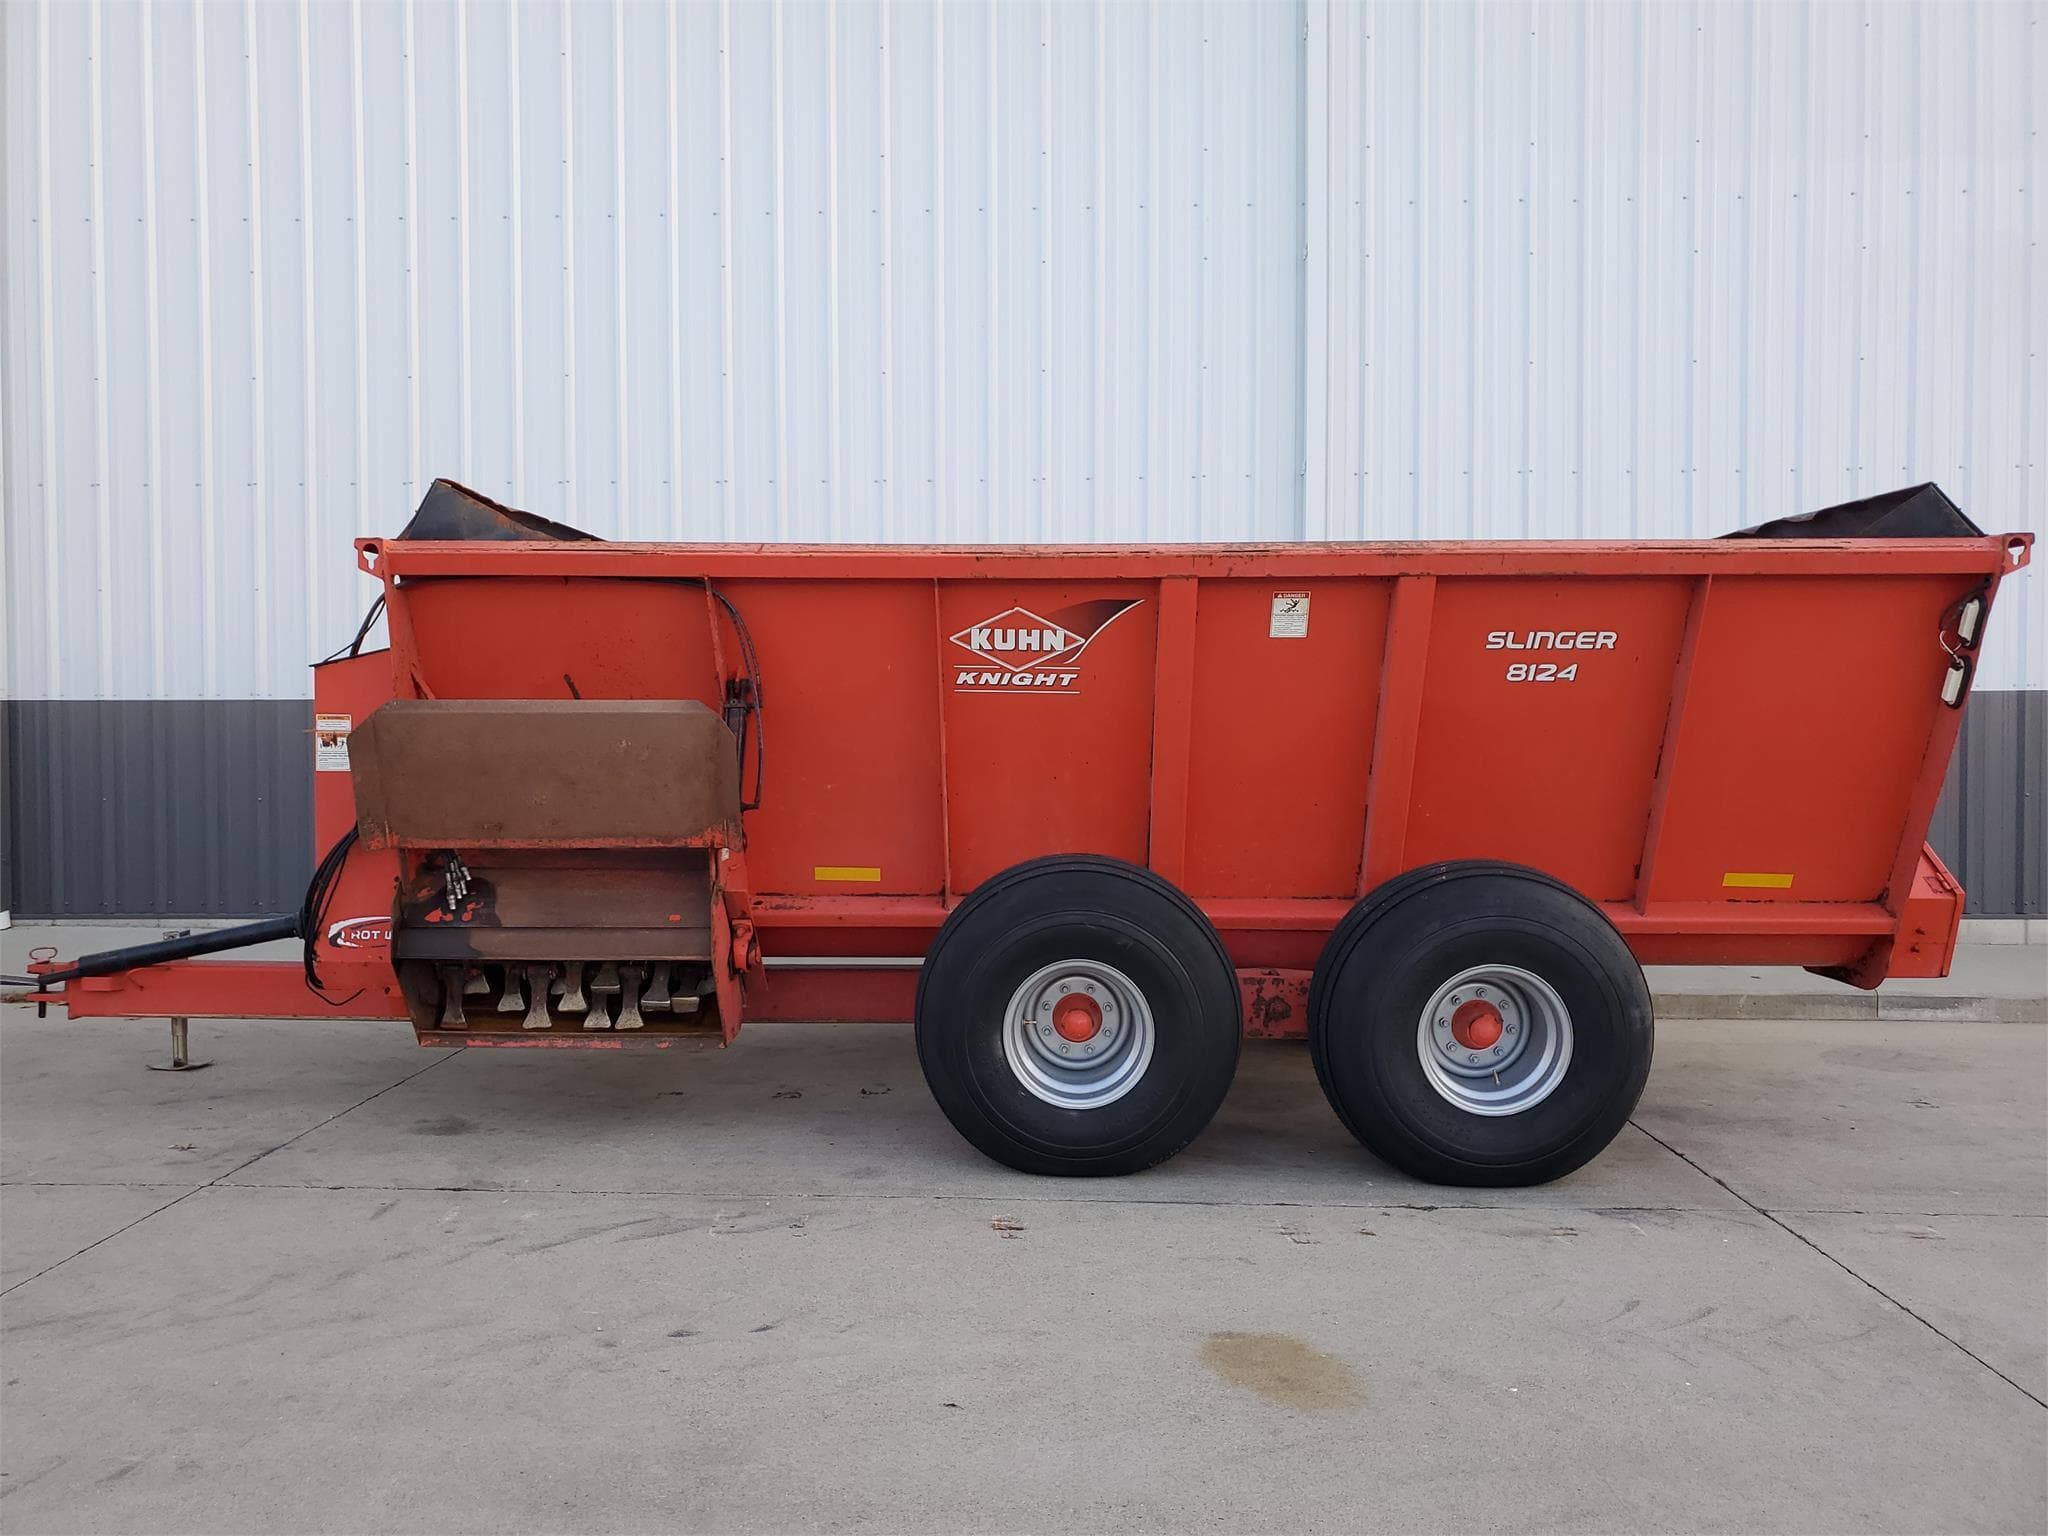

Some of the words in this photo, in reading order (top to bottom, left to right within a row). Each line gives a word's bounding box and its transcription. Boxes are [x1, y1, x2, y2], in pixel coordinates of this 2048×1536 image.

[970, 627, 1065, 651] KUHN
[1485, 631, 1618, 649] SLINGER
[956, 672, 1078, 686] KNIGHT
[1506, 663, 1578, 682] 8124
